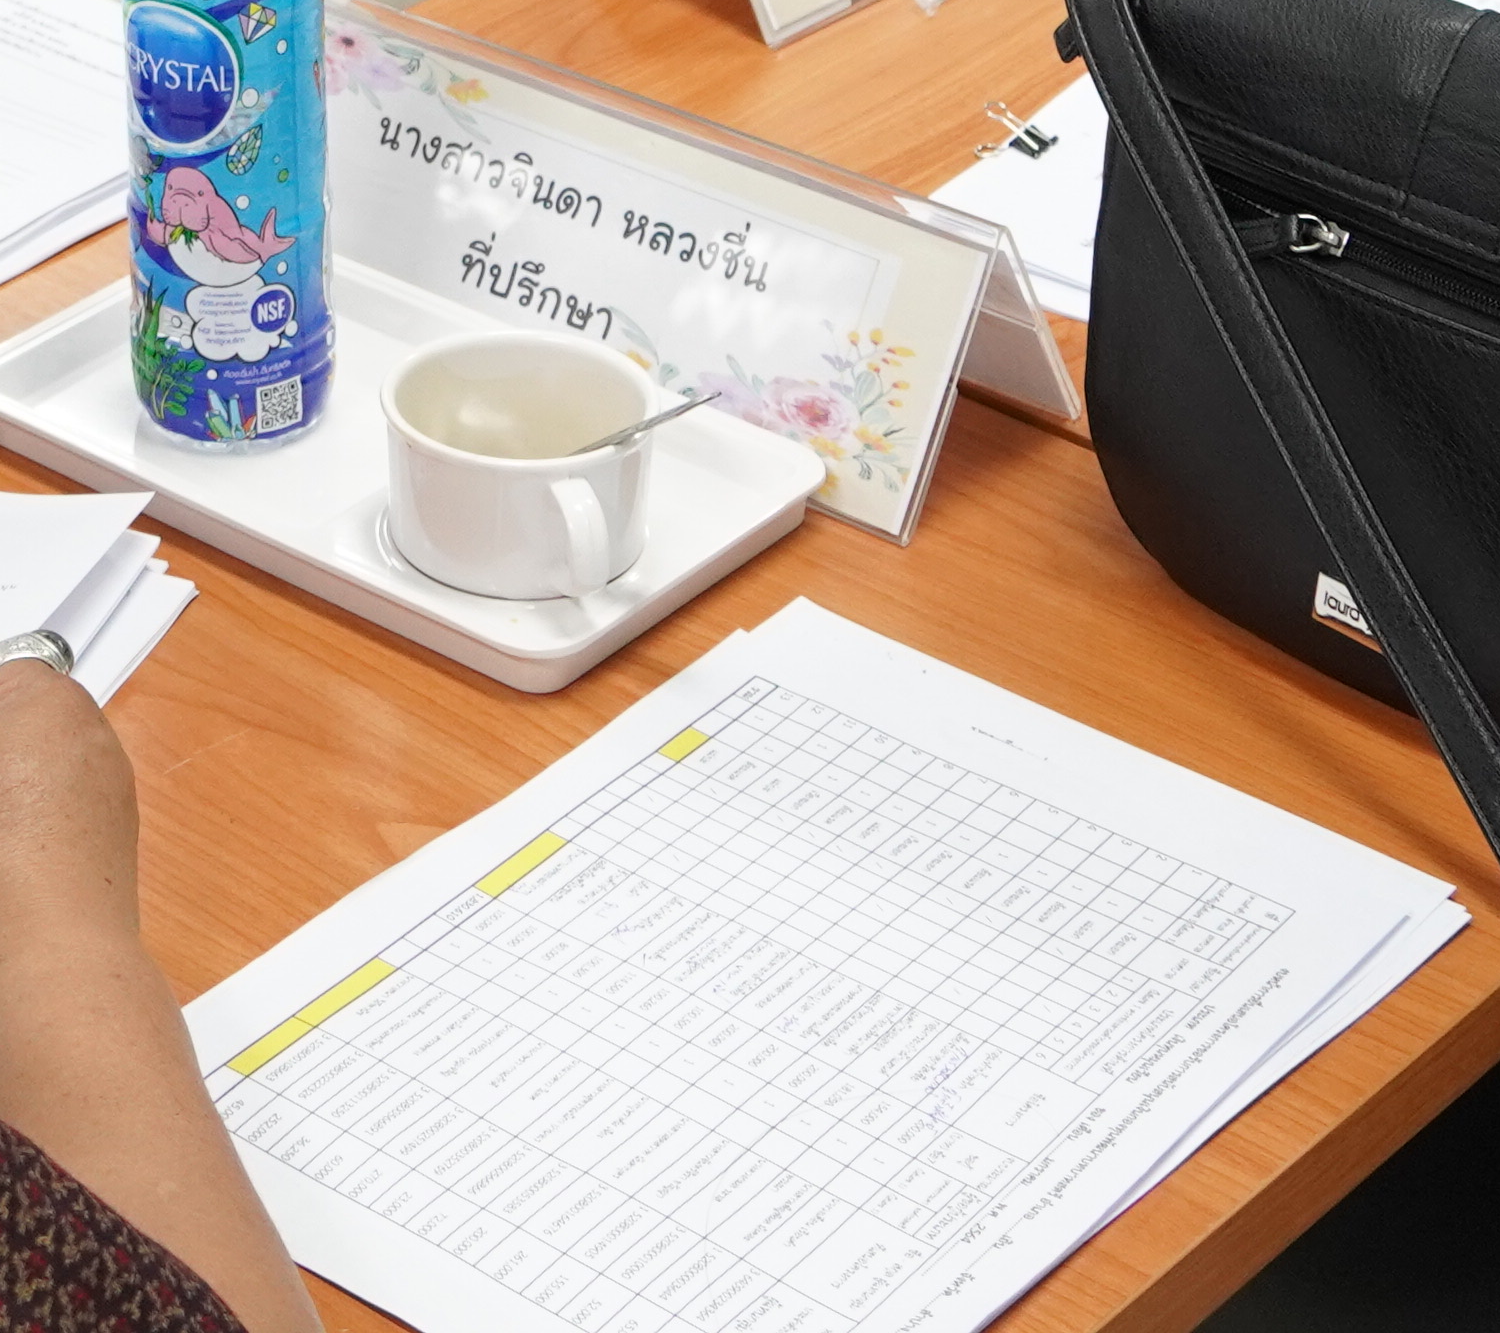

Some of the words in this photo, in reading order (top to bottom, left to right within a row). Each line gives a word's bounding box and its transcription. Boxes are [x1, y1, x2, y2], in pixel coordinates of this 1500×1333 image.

[128, 42, 233, 93] CRYSTAL
[379, 116, 604, 229] นางสาวจินดา
[622, 222, 769, 293] หลวงชื่น
[460, 239, 616, 341] ที่ปรึกษา
[256, 298, 286, 325] NSF
[1323, 590, 1361, 623] laura
[444, 892, 484, 921] 1,830,610
[957, 1221, 987, 1245] 2564
